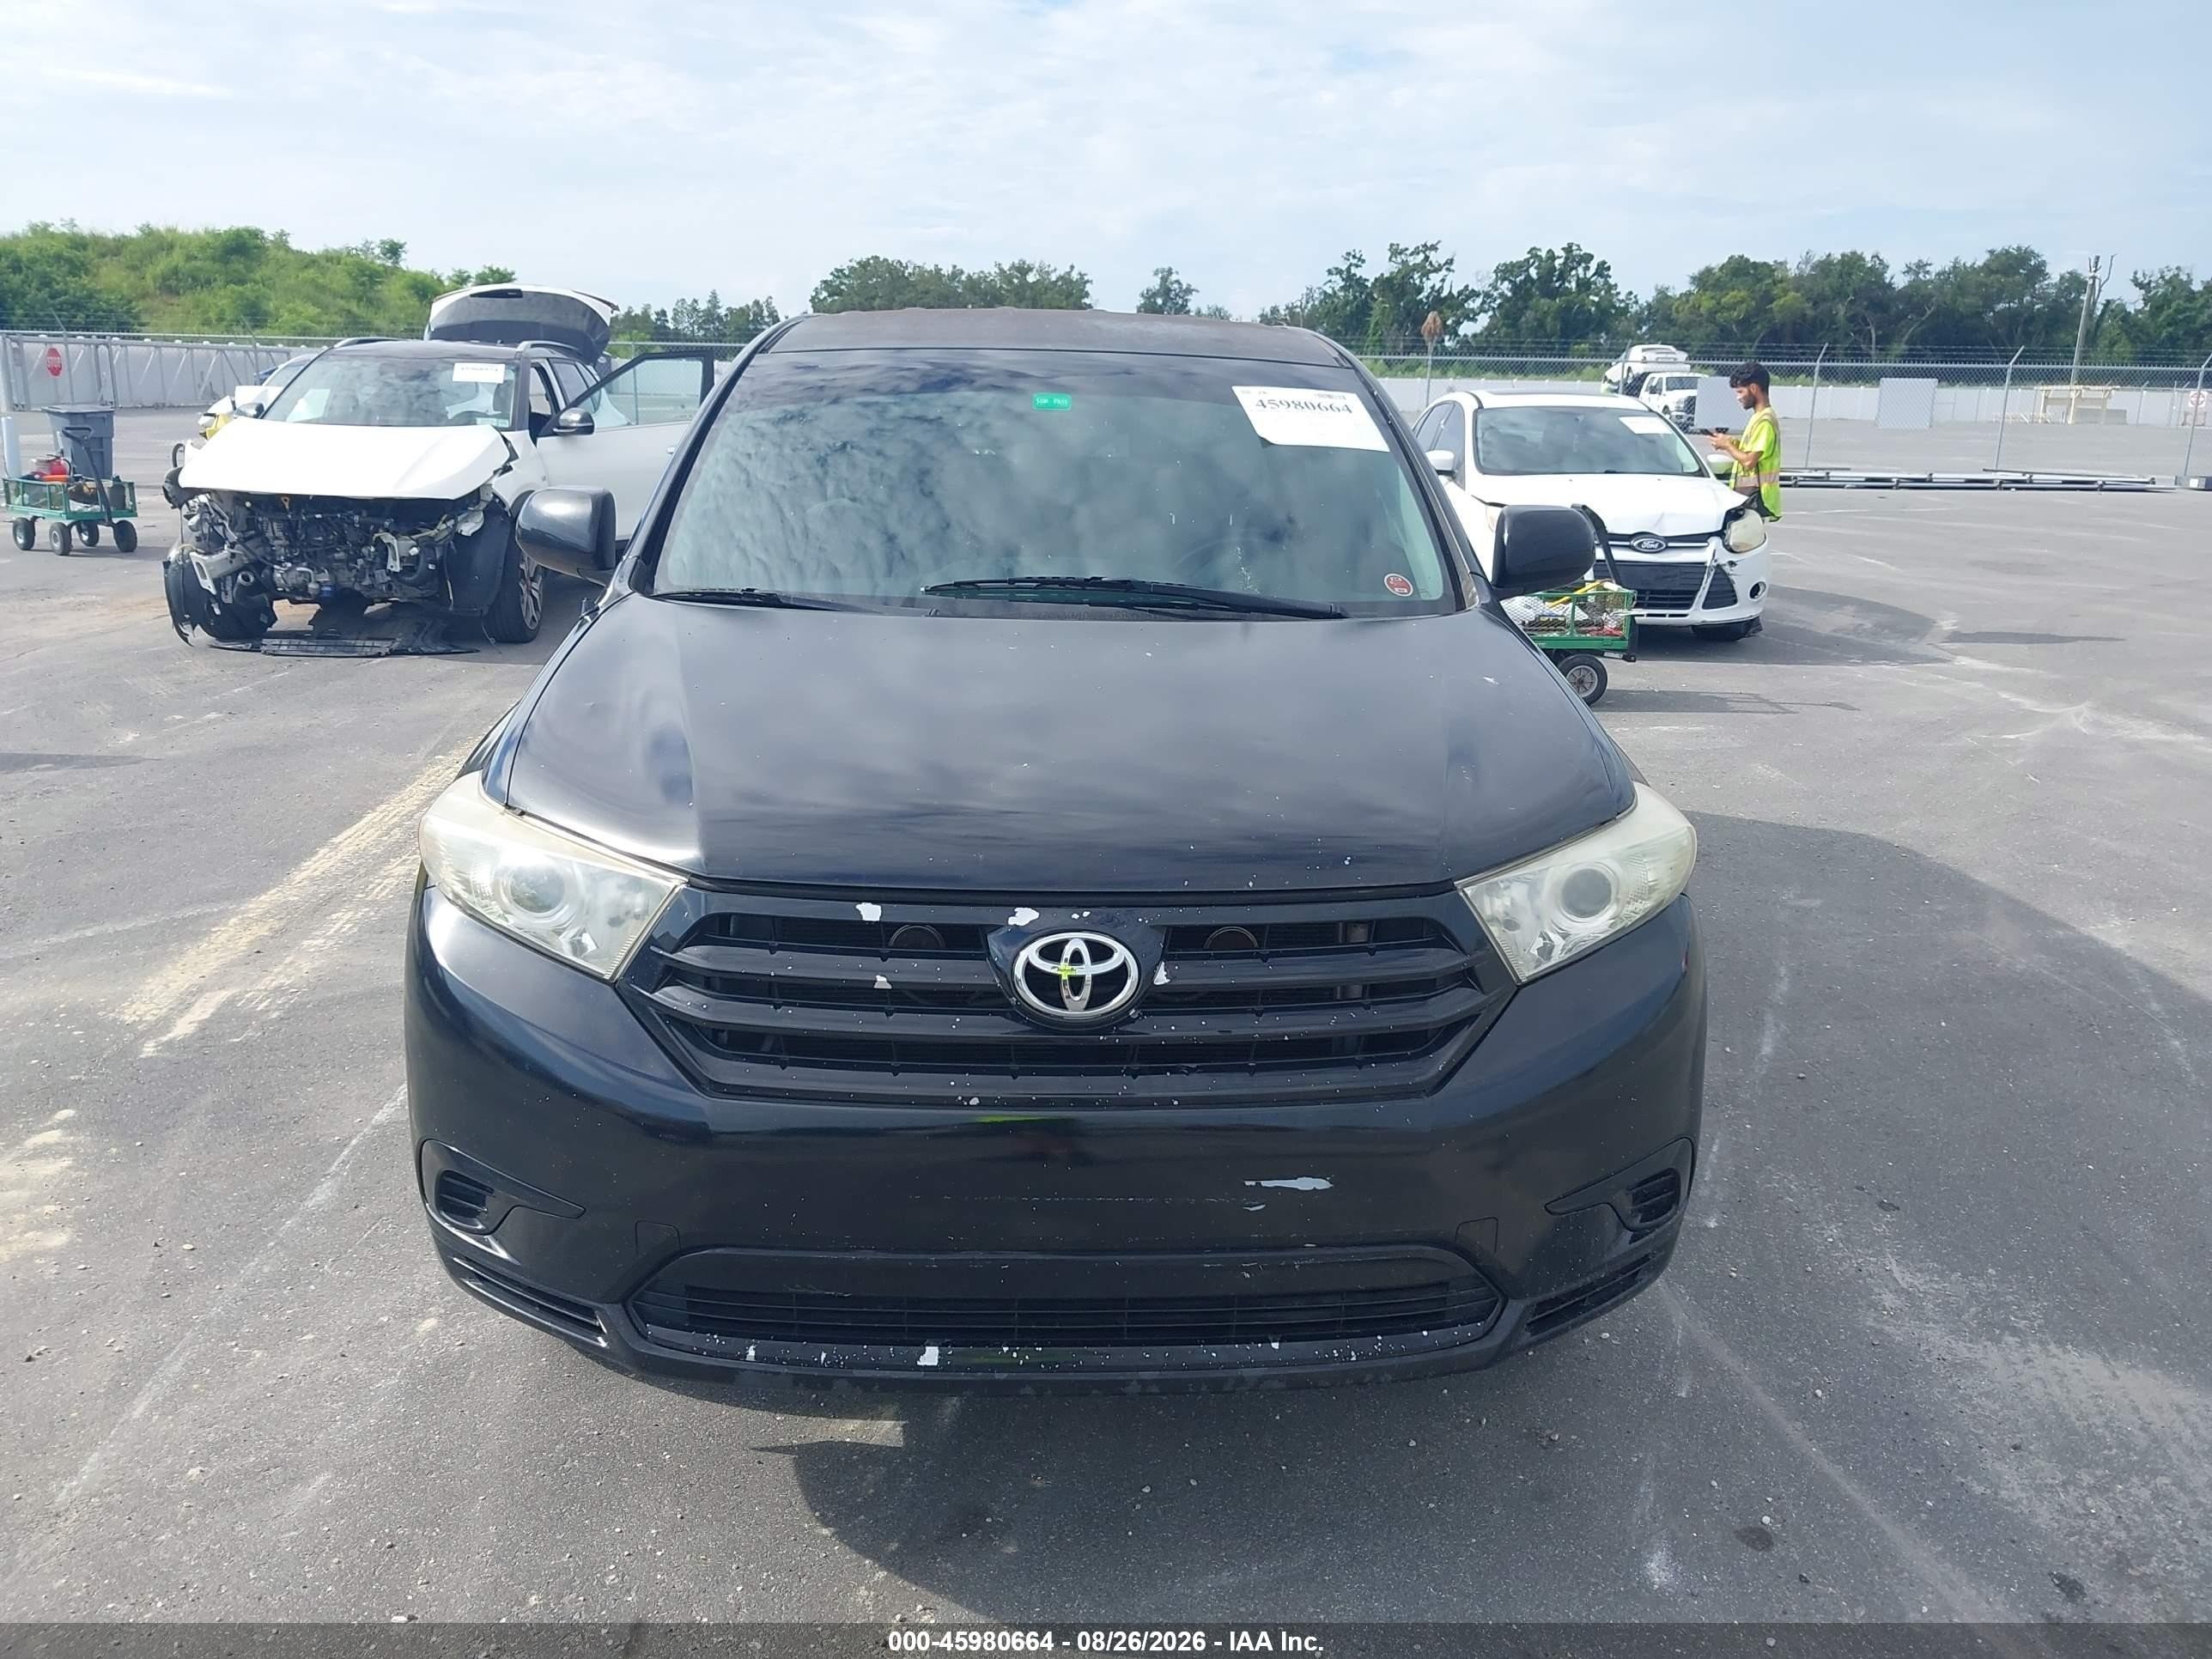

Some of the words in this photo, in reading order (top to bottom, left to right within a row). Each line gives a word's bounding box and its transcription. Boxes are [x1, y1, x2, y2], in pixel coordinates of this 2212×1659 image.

[47, 356, 62, 368] STOP
[1255, 398, 1353, 414] 45980664
[1641, 540, 1659, 549] Ford
